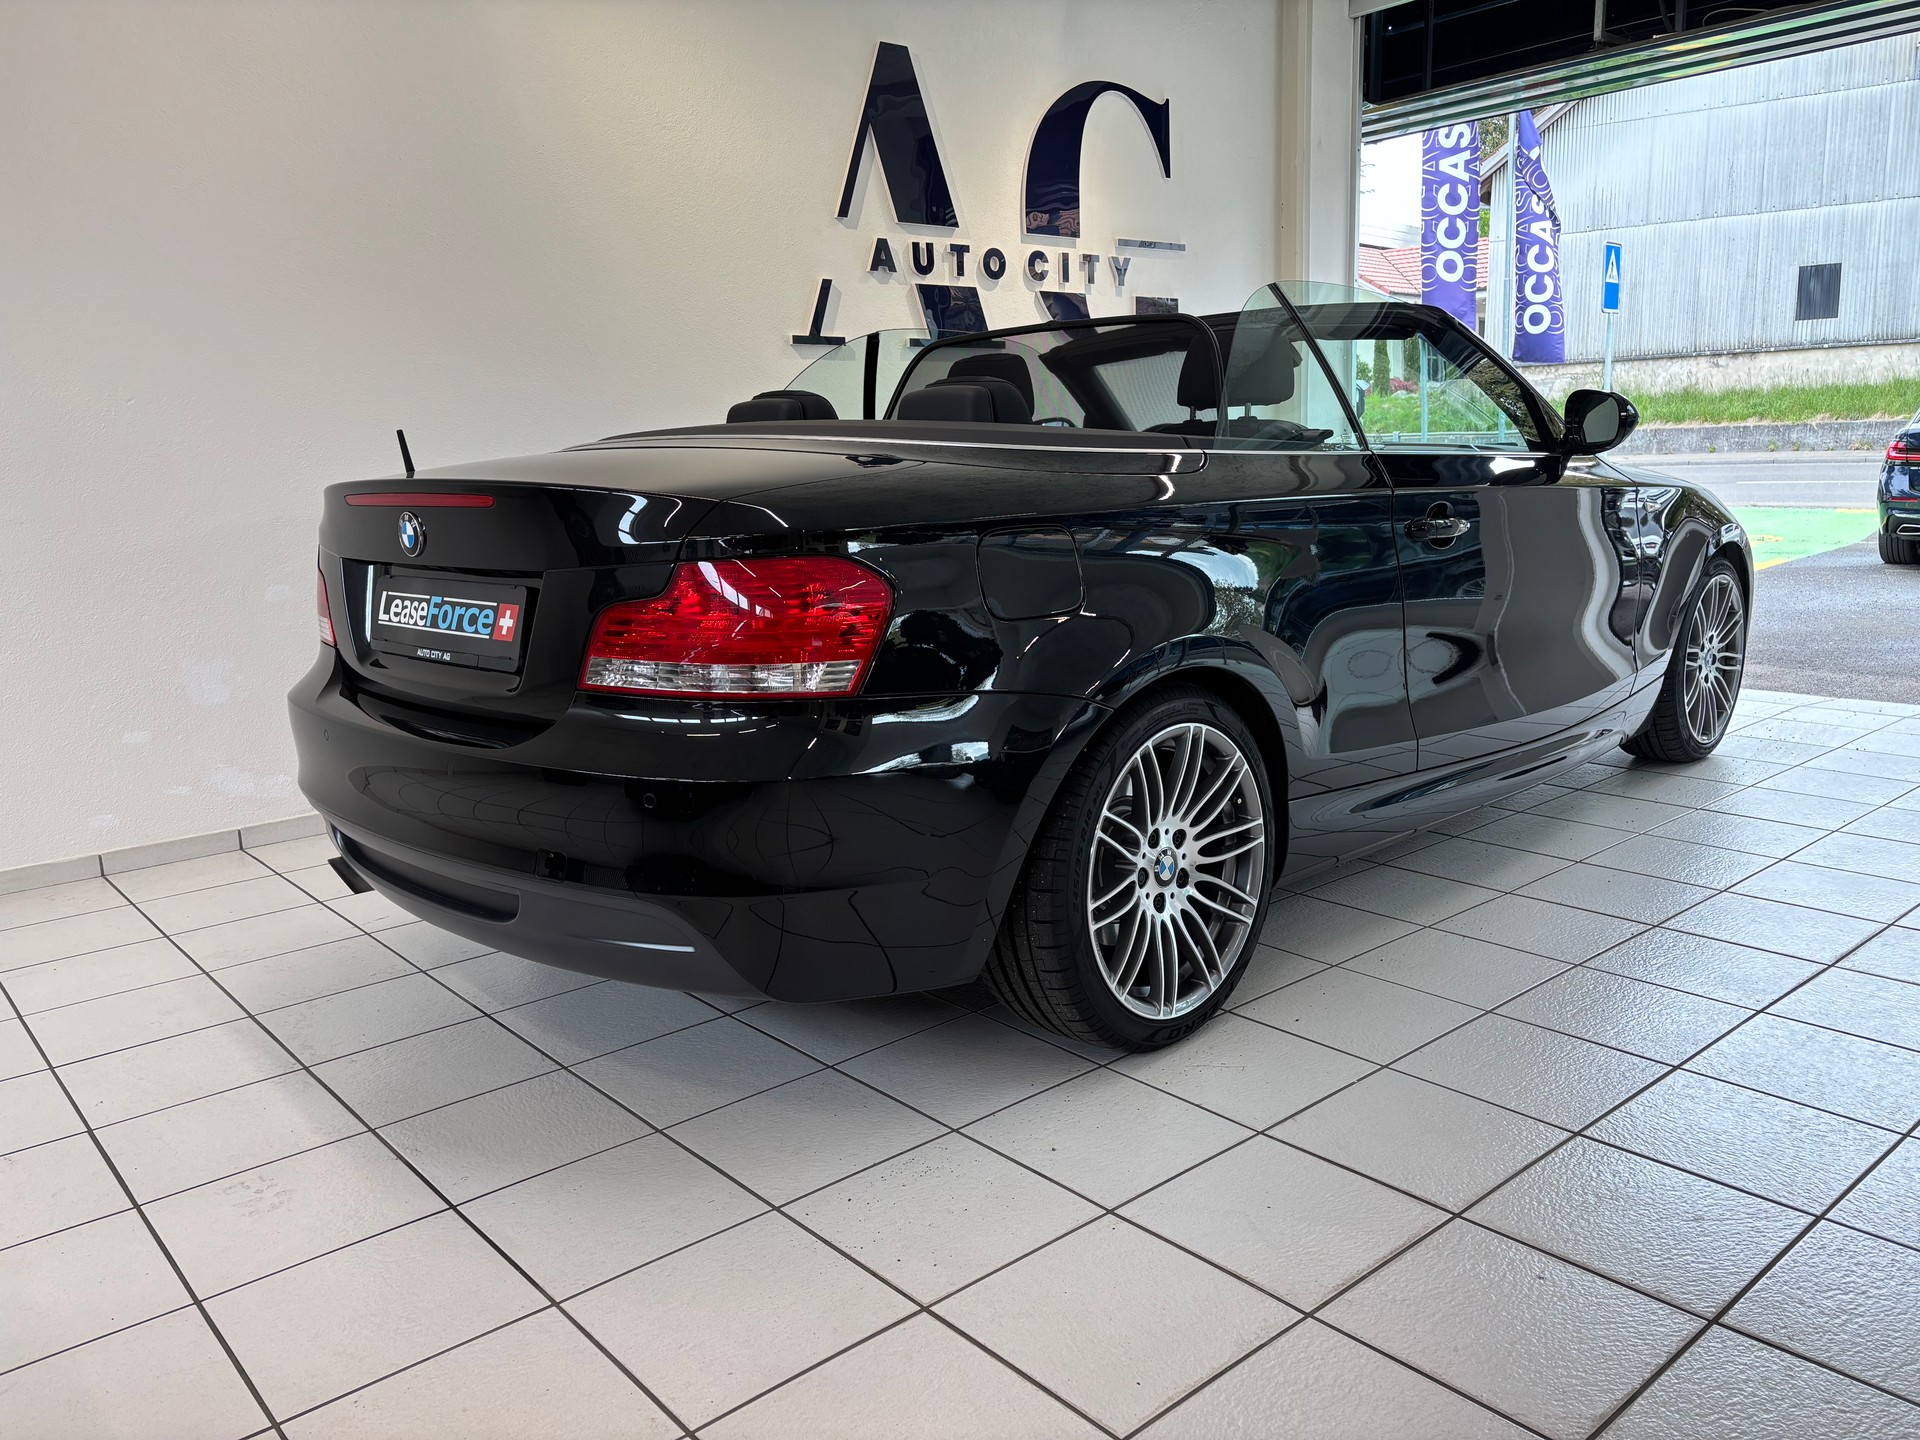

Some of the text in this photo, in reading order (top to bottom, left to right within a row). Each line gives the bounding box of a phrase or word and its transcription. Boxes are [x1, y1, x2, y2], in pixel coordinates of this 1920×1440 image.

[869, 237, 1132, 287] AUTO CITY
[378, 591, 494, 634] LeaseForce
[417, 648, 451, 660] AUTO CITY AG
[1167, 998, 1221, 1040] ZERO
